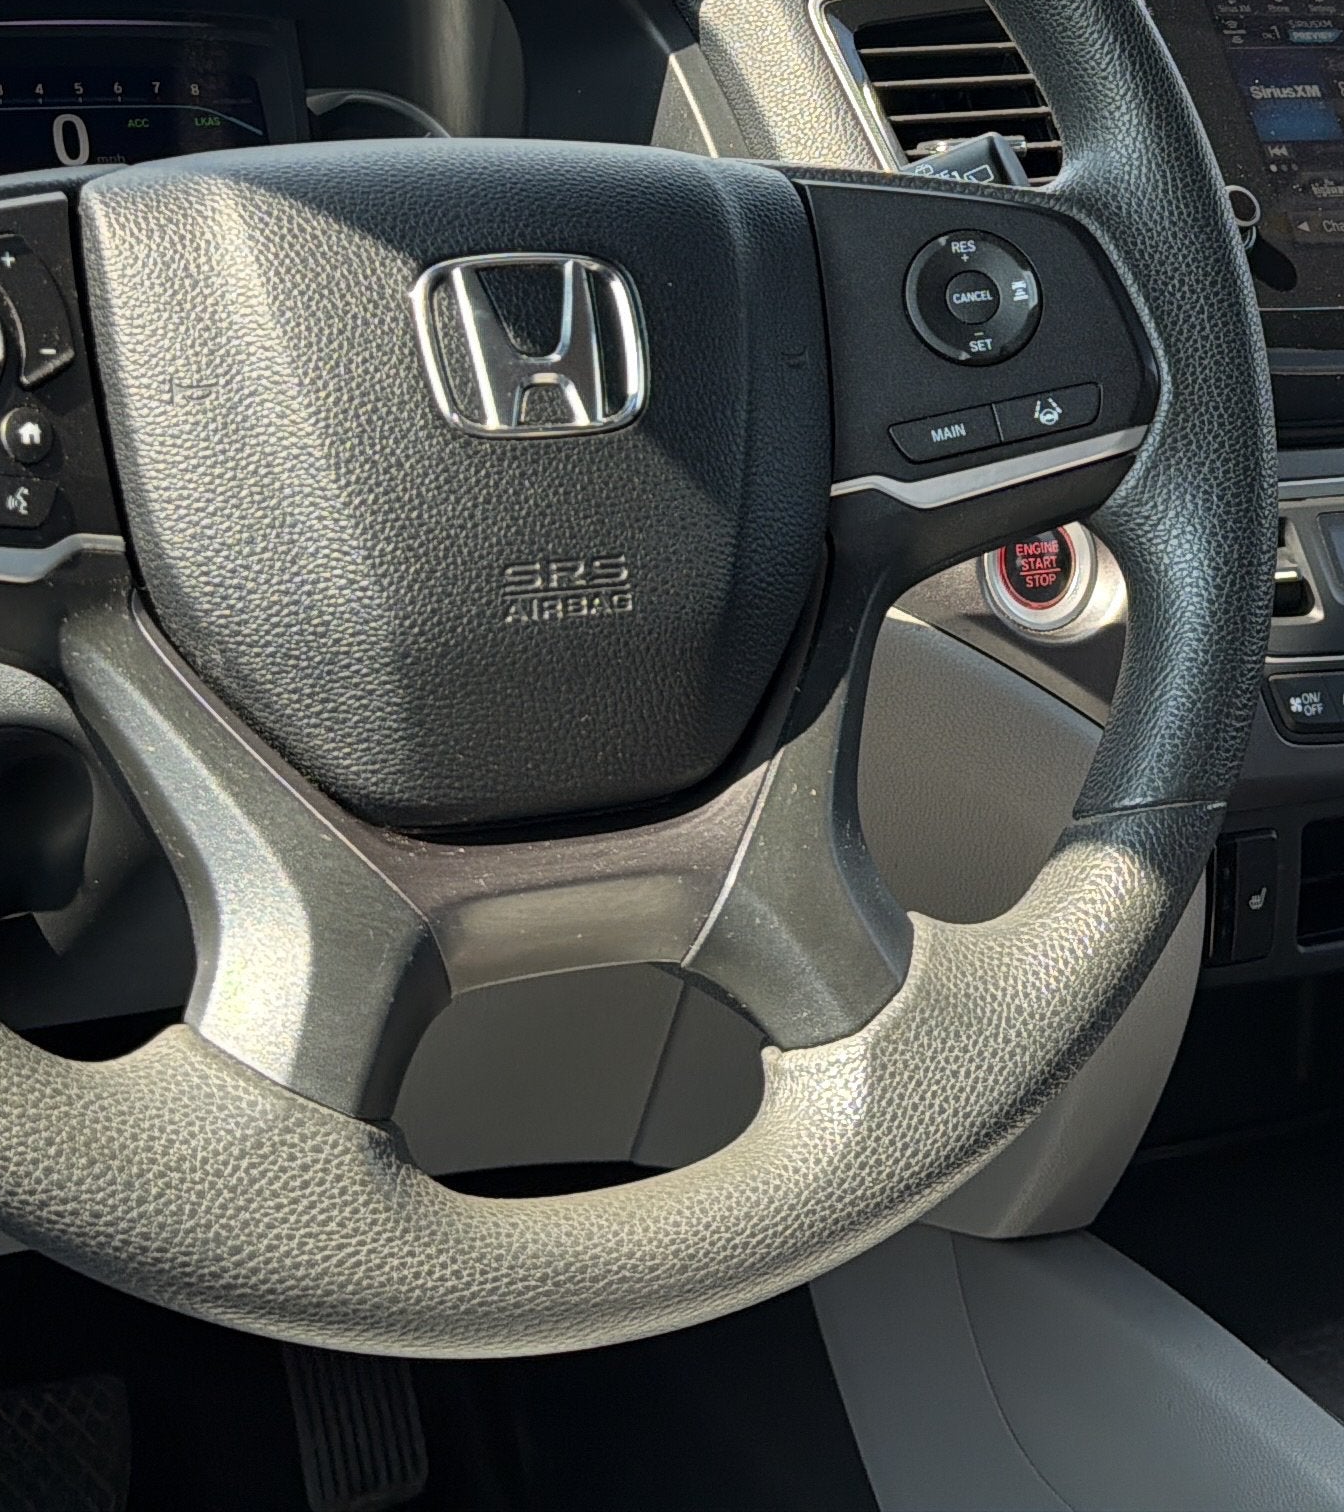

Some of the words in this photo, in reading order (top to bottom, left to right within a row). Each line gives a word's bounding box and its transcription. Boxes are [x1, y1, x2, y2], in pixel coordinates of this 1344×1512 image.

[34, 84, 45, 95] 4
[74, 83, 84, 95] 5
[113, 83, 123, 95] 6
[152, 82, 161, 94] 7
[191, 84, 200, 96] 8
[1250, 85, 1321, 100] SiriusXM
[127, 118, 150, 129] ACC
[194, 116, 222, 128] LKAS
[52, 113, 91, 167] 0
[951, 240, 976, 254] RES
[952, 290, 993, 304] CANCEL
[969, 338, 993, 353] SET
[930, 423, 966, 443] MAIN
[1015, 540, 1060, 556] ENGINE
[504, 554, 631, 587] SRS
[1021, 555, 1057, 571] START
[1025, 573, 1057, 588] STOP
[504, 593, 634, 624] AIRBAG
[1301, 691, 1321, 704] ON/
[1304, 703, 1324, 717] OFF
